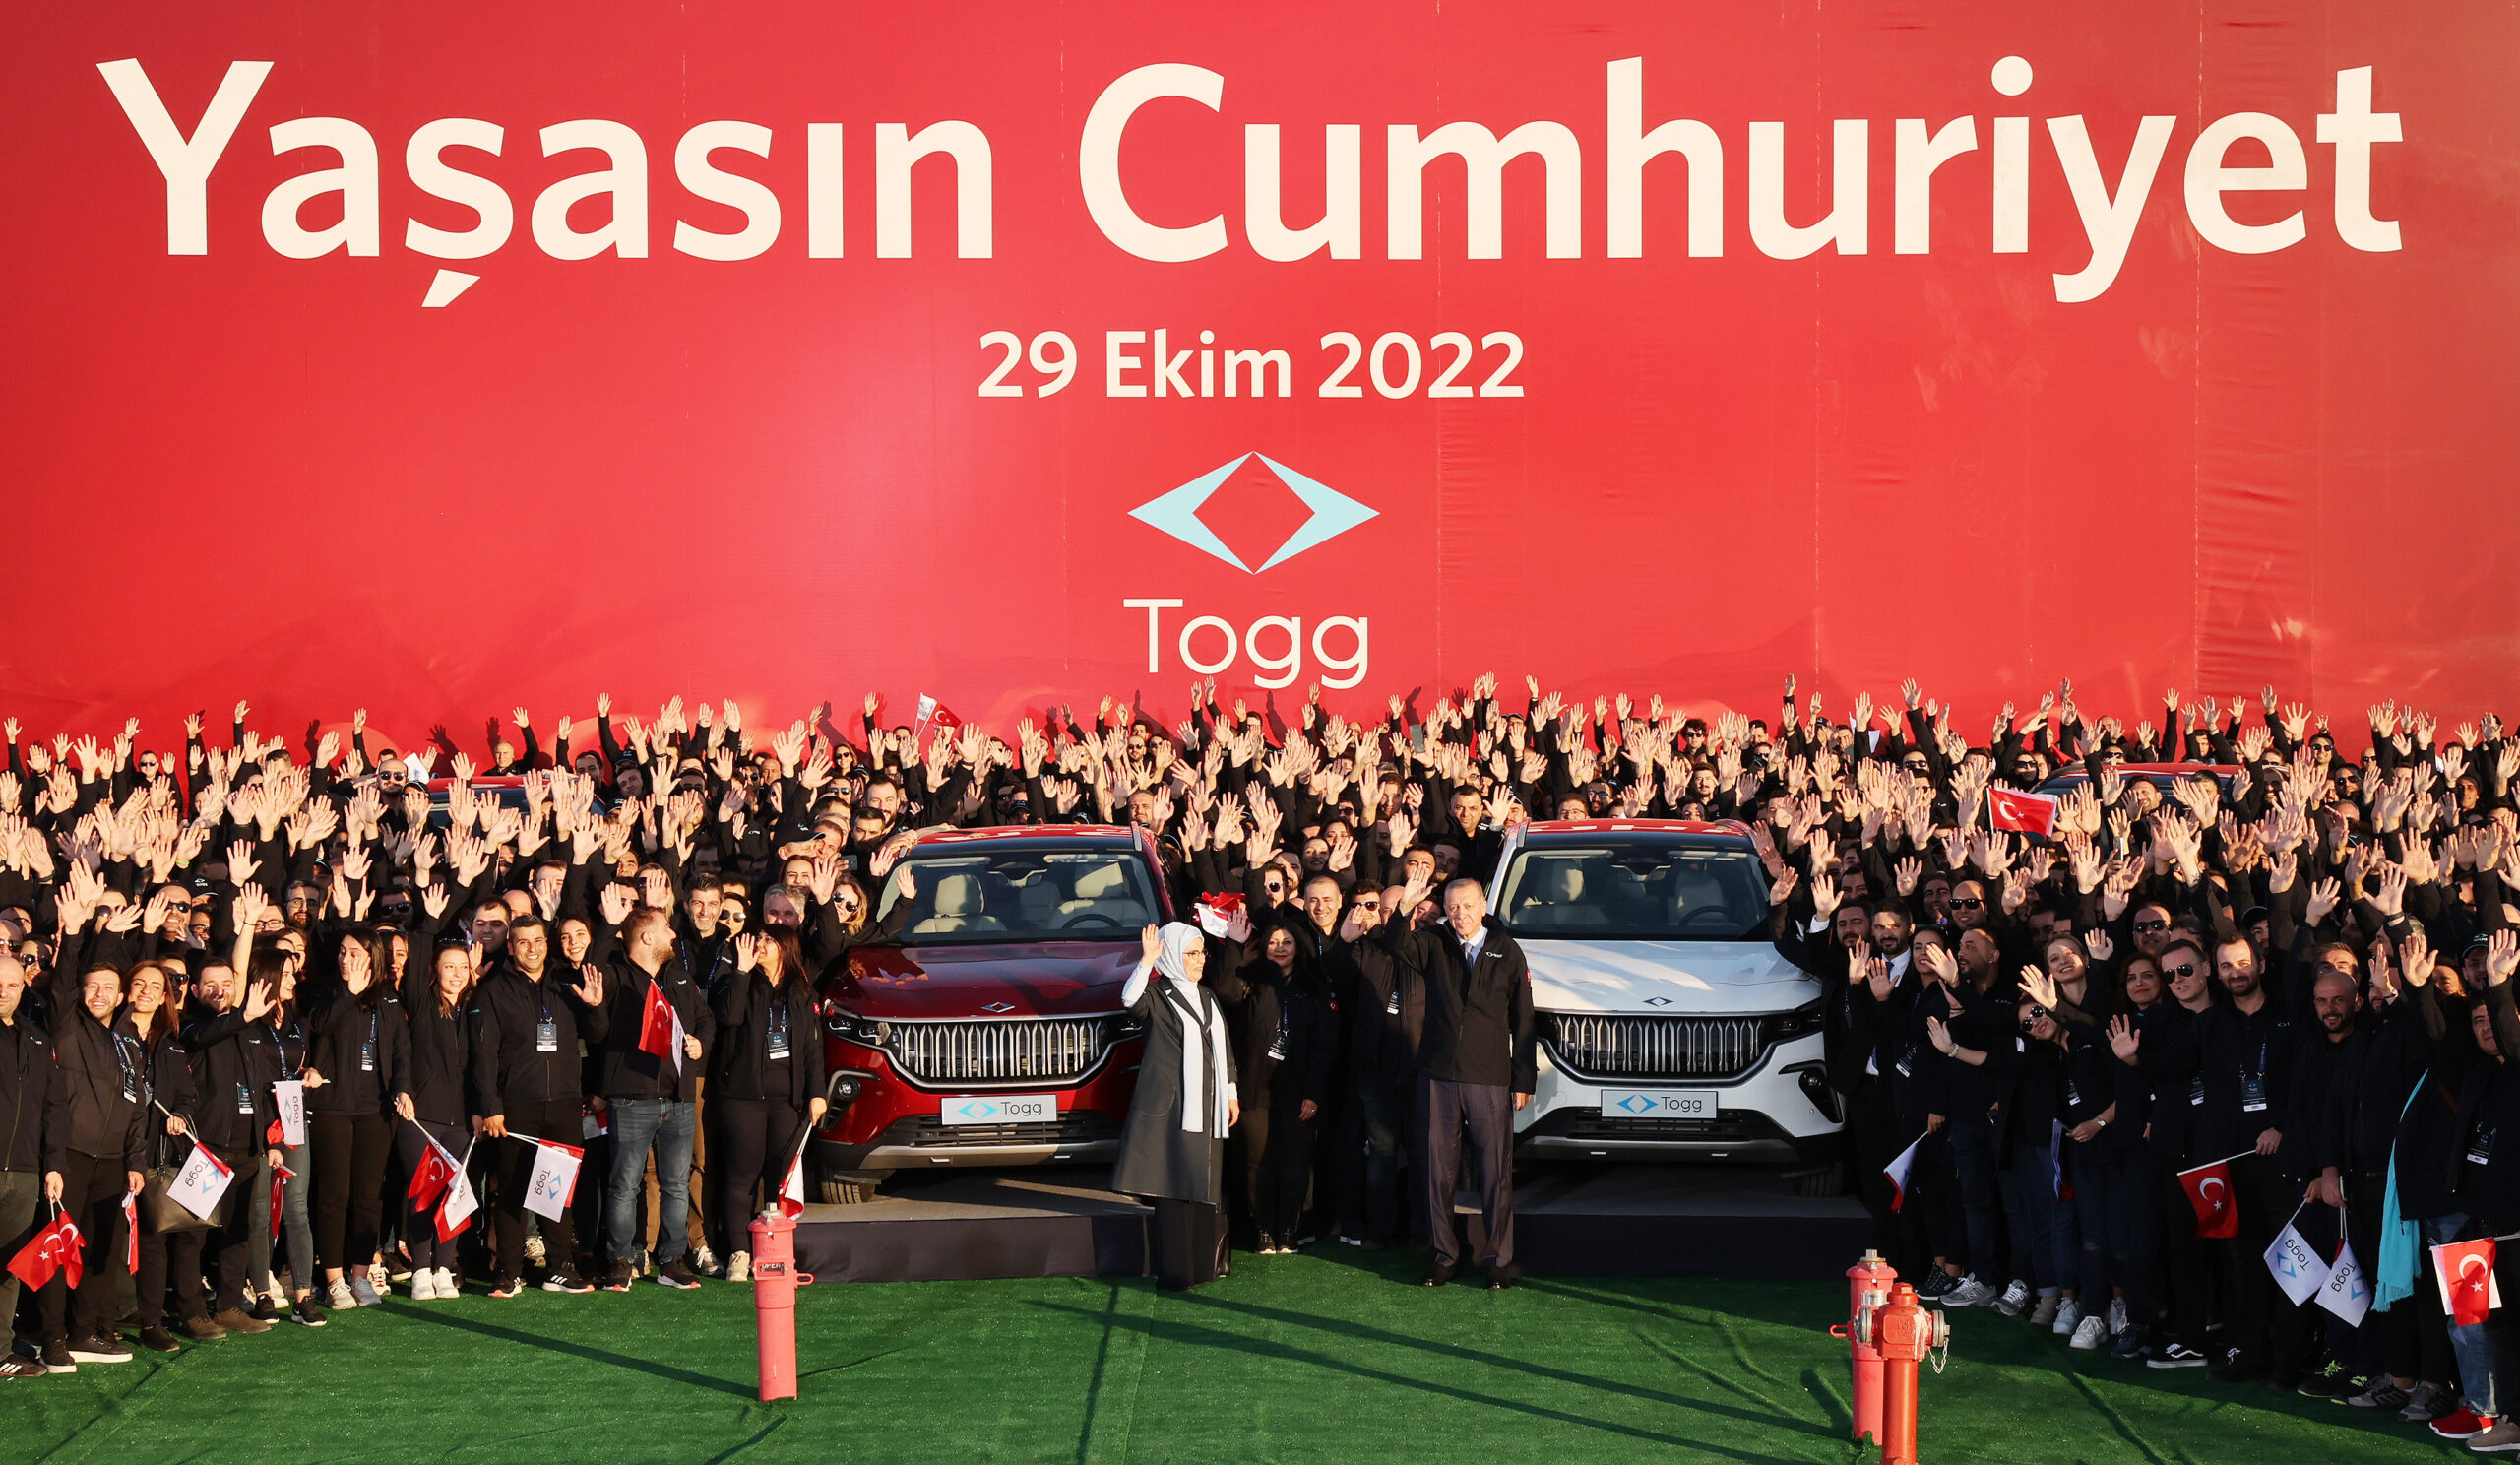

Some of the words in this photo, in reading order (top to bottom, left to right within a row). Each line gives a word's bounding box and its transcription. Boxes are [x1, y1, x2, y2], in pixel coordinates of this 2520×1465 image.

[96, 58, 993, 308] Yaşasın
[1079, 55, 2403, 302] Cumhuriyet
[978, 331, 1078, 399] 29
[1106, 328, 1291, 398] Ekim
[1318, 331, 1525, 399] 2022
[1123, 598, 1368, 690] Togg
[1000, 1101, 1042, 1117] Togg
[1660, 1096, 1702, 1113] Togg
[184, 1159, 211, 1187] Togg
[535, 1169, 552, 1196] Togg
[2284, 1238, 2310, 1272] Togg
[2330, 1262, 2357, 1293] Togg
